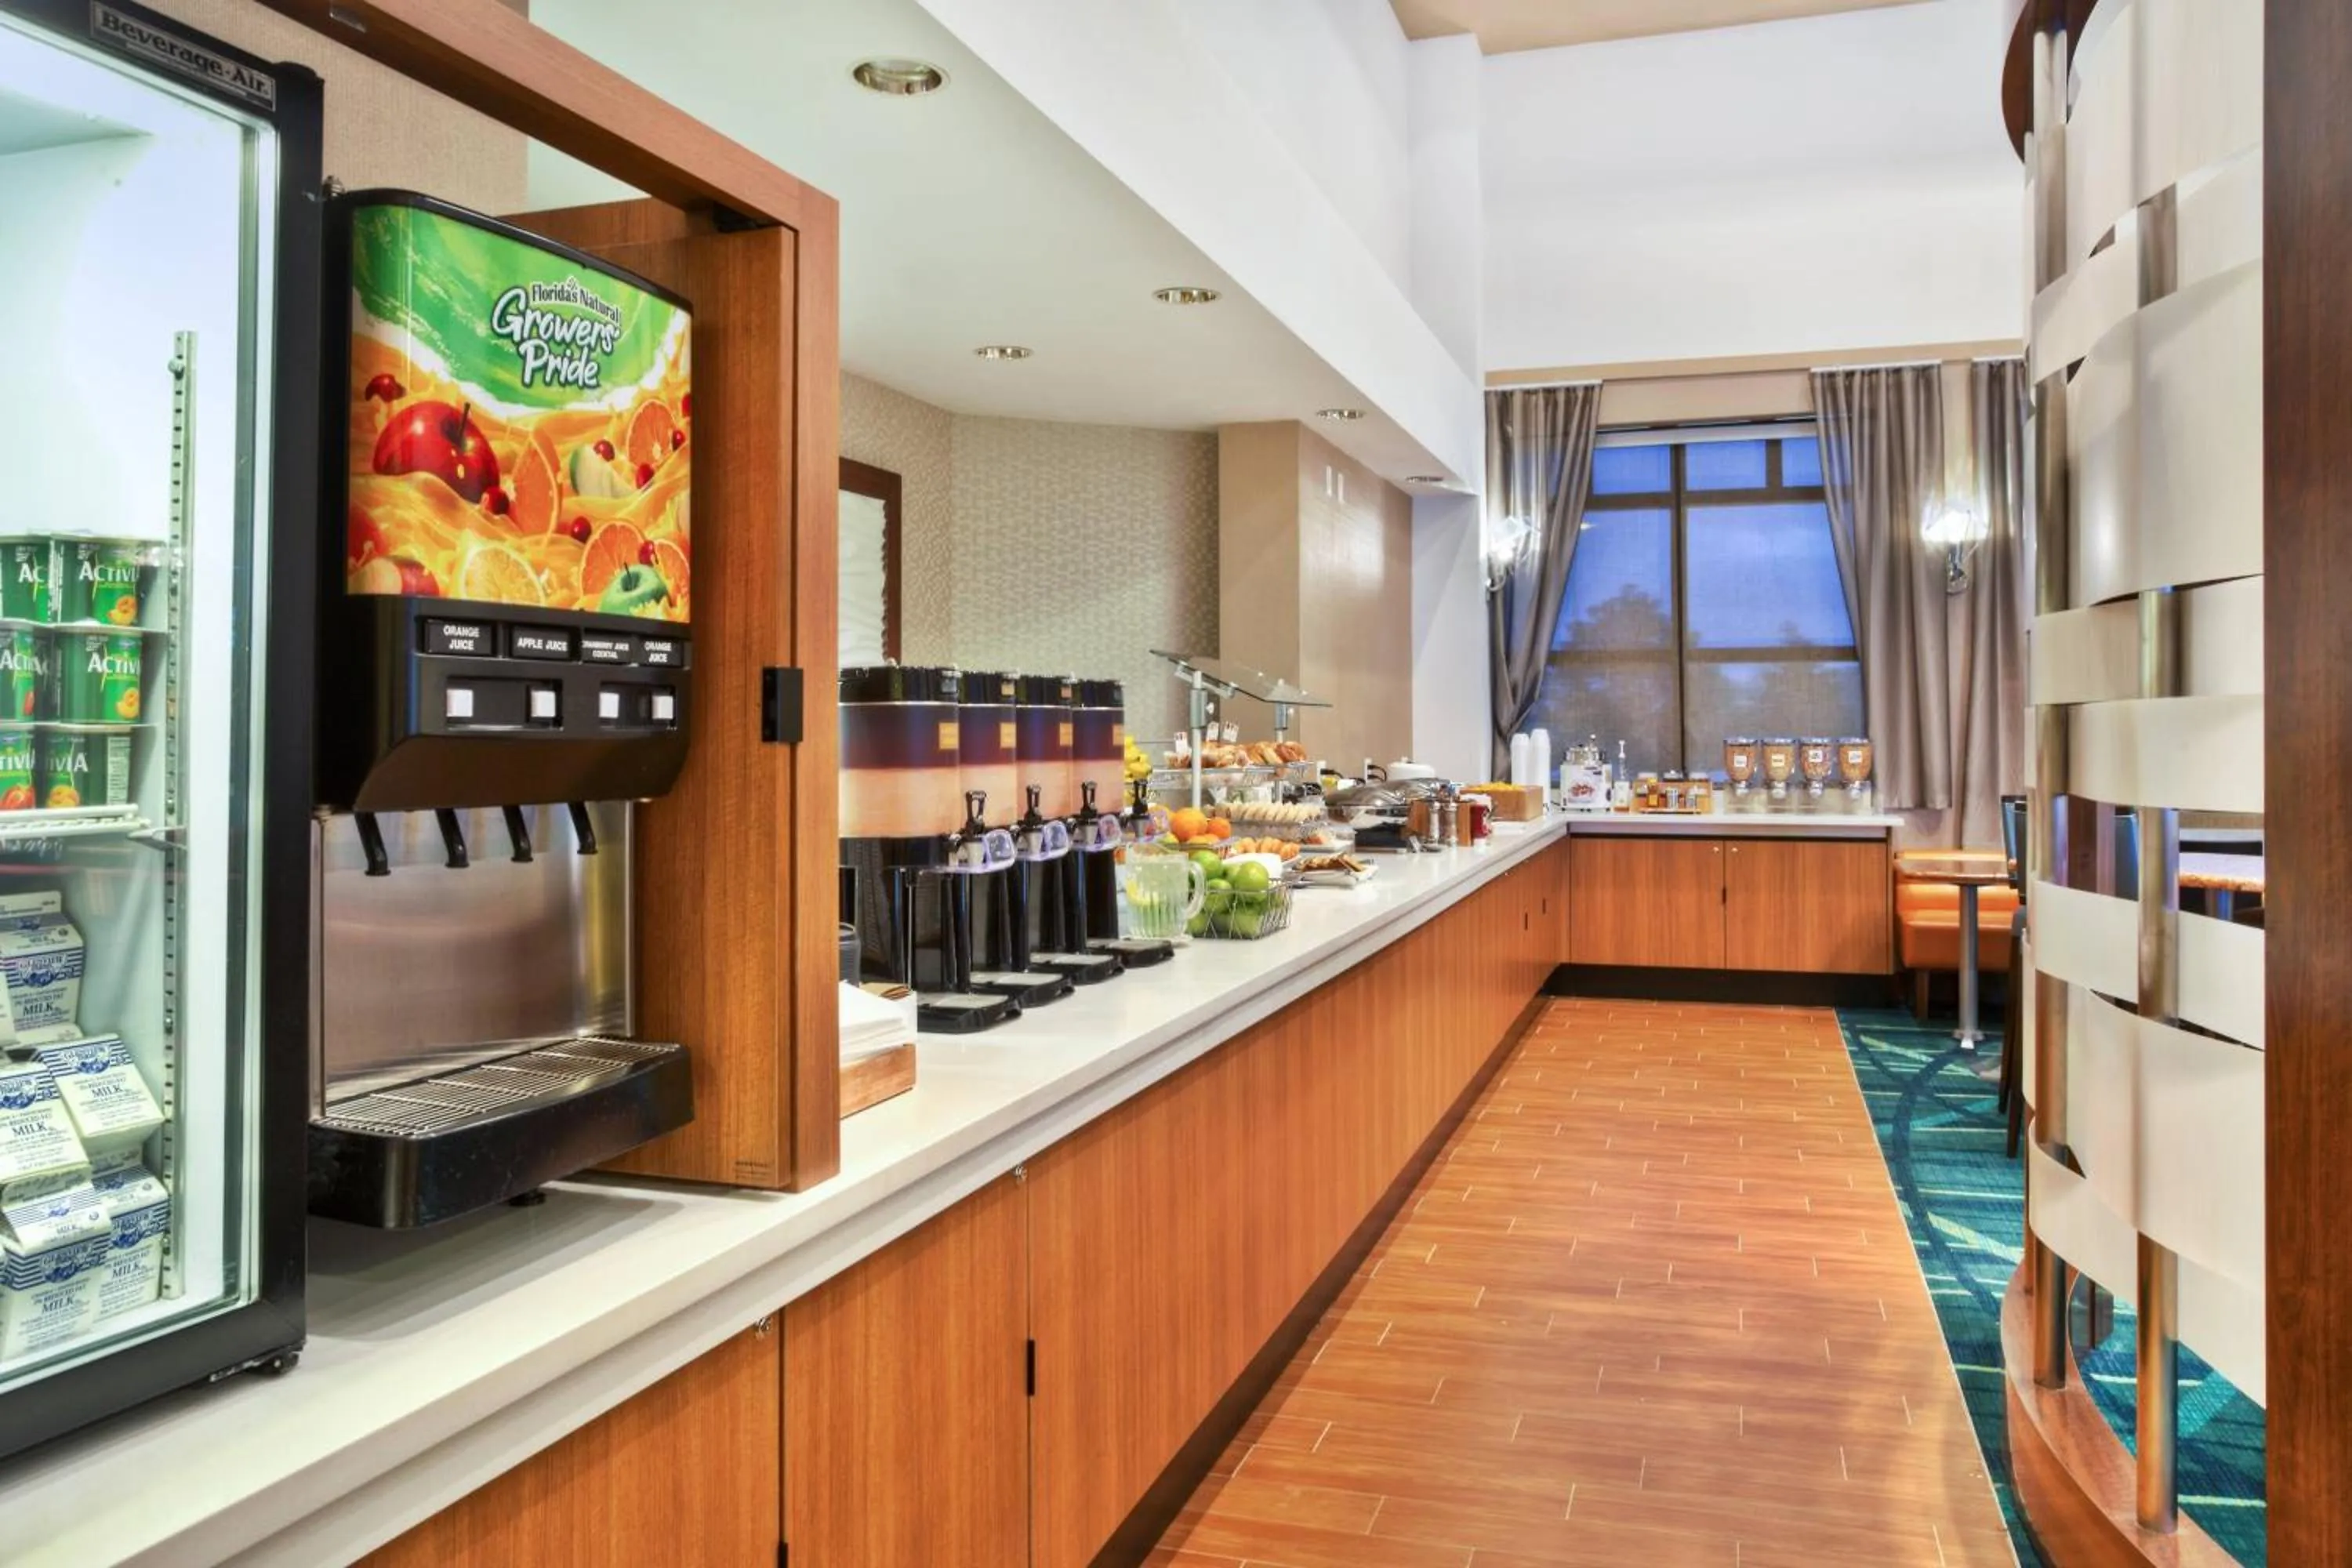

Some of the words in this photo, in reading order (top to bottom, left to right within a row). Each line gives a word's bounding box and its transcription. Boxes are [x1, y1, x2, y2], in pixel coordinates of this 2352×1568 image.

[579, 288, 619, 322] Natural
[518, 337, 599, 387] Pride
[443, 625, 480, 637] ORANGE
[448, 639, 474, 651] JUICE
[517, 637, 543, 649] APPLE
[545, 639, 568, 652] JUICE
[644, 641, 672, 652] ORANGE
[648, 653, 668, 663] JUICE
[24, 1002, 54, 1017] MILK
[91, 1083, 123, 1098] MILK
[12, 1121, 48, 1137] MILK
[112, 1260, 141, 1279] MILK
[42, 1295, 74, 1315] MILK
